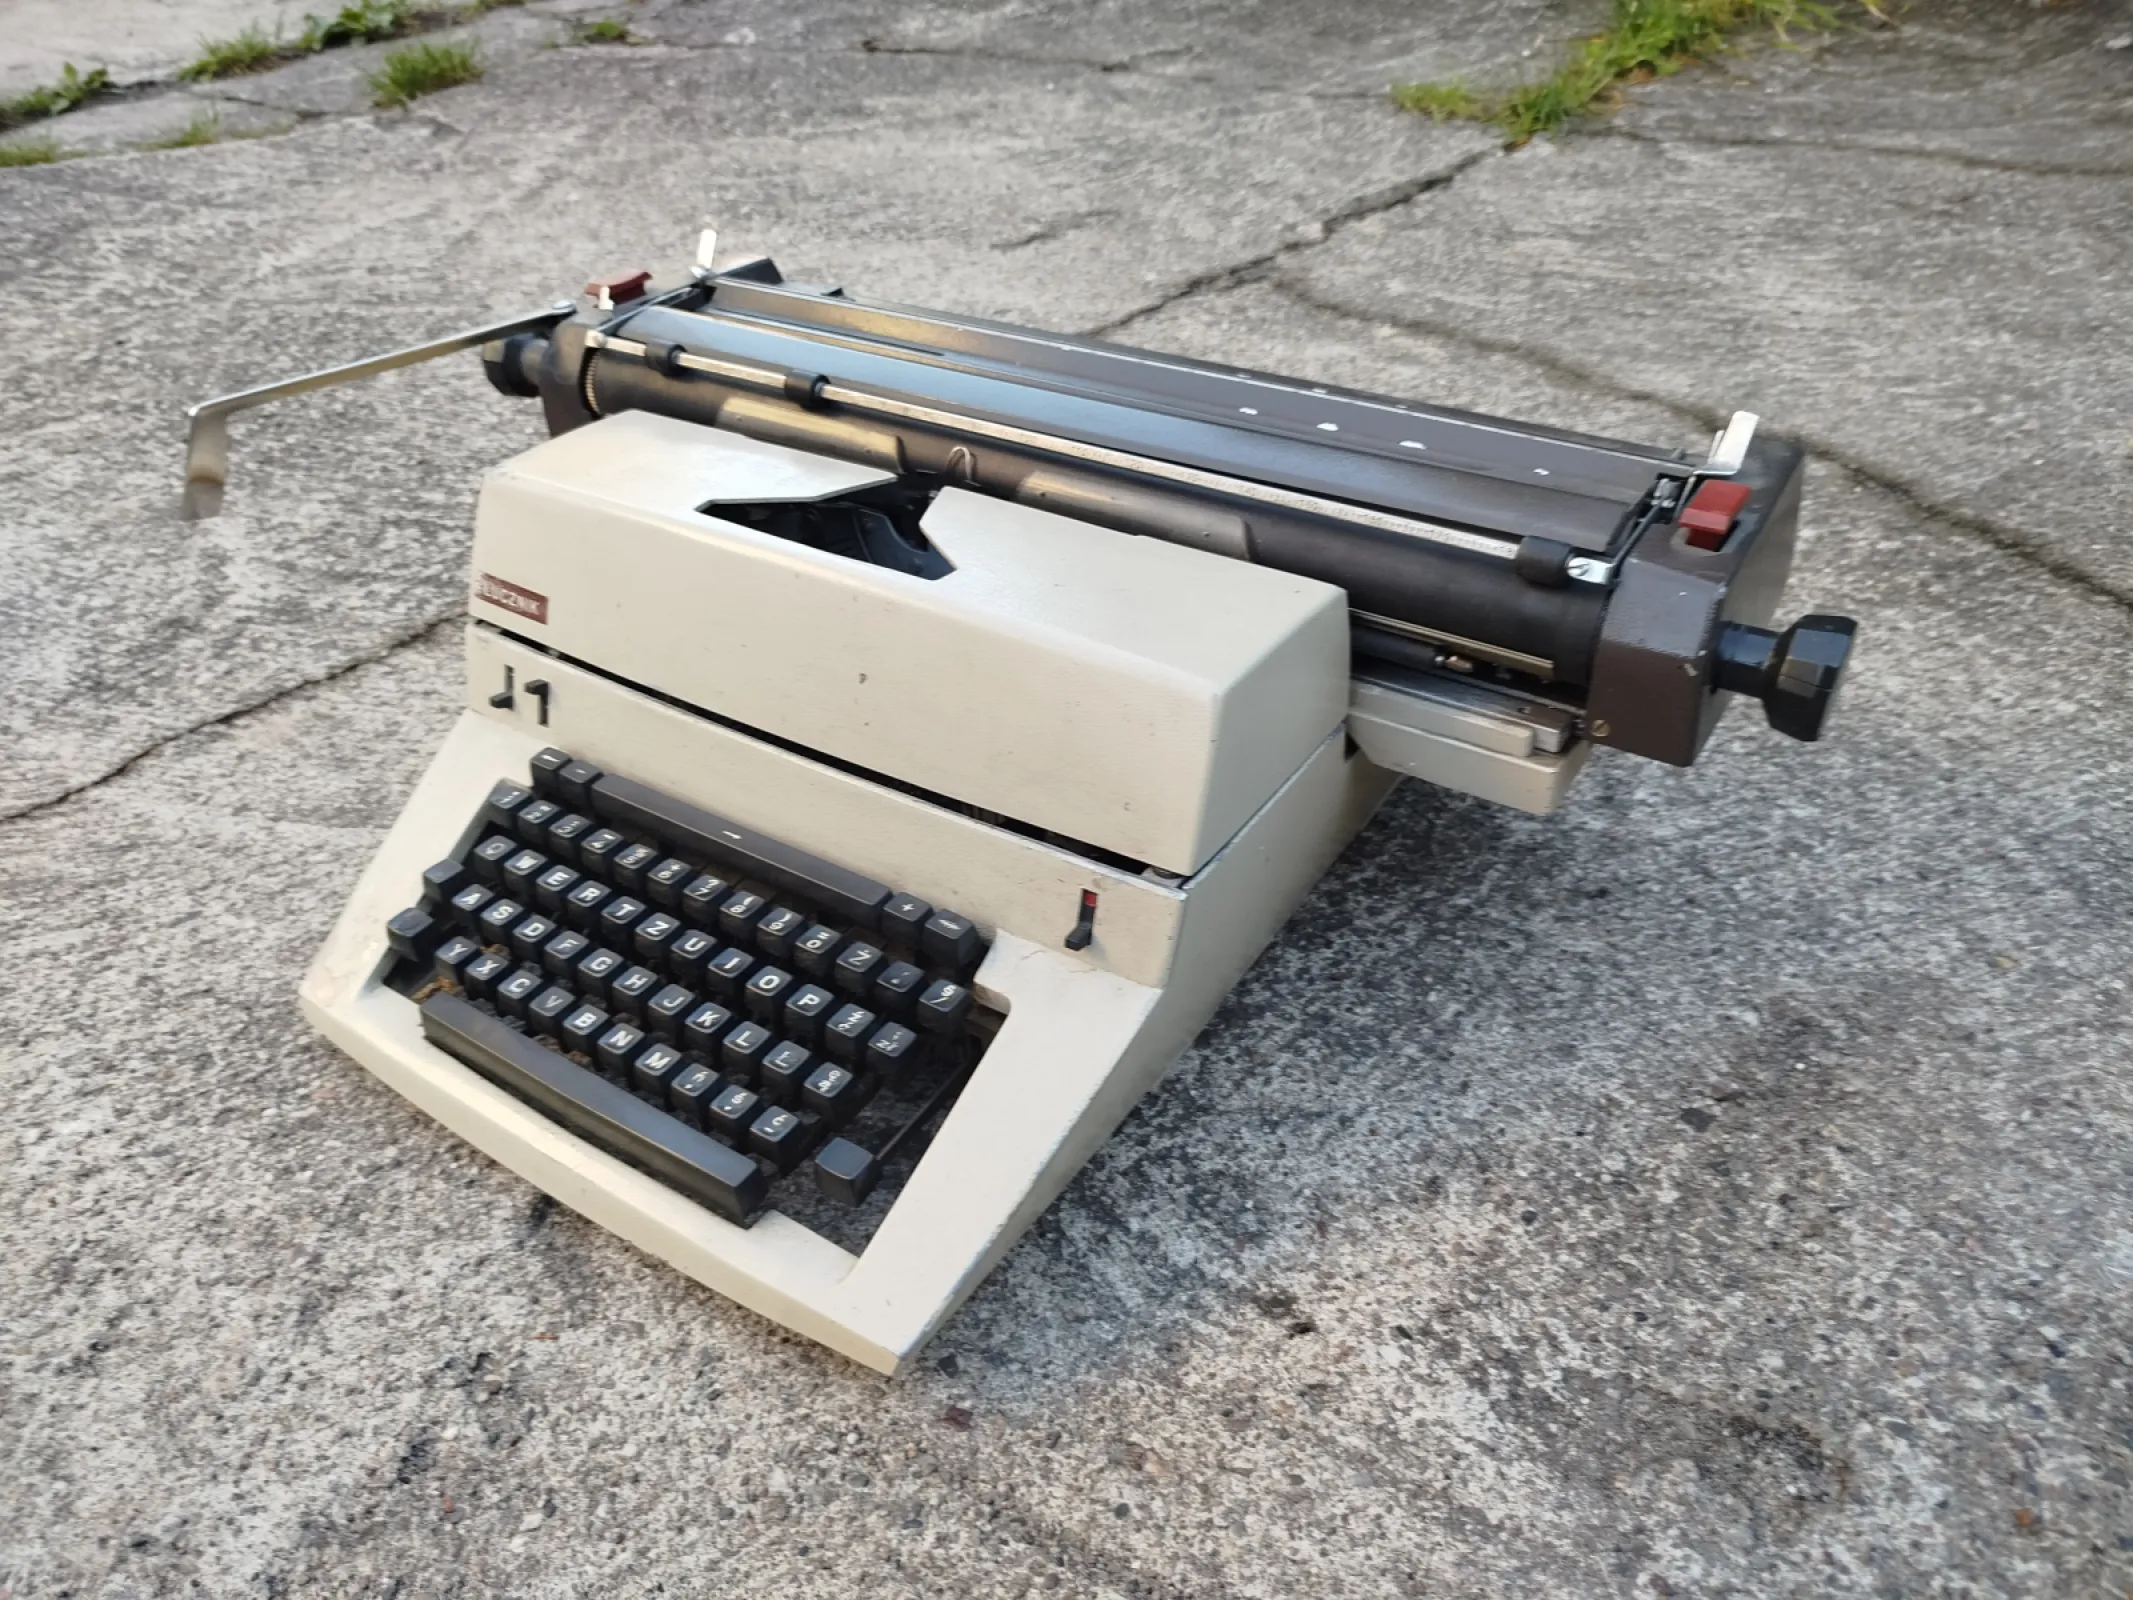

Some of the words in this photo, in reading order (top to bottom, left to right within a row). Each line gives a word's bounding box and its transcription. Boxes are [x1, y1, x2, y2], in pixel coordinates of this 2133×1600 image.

[460, 893, 481, 905] A
[492, 905, 513, 919] S
[523, 922, 545, 936] D
[557, 939, 579, 949] F
[590, 956, 612, 970] G
[624, 974, 648, 989] H
[663, 996, 685, 1008] J
[696, 1010, 720, 1026] K
[735, 1030, 751, 1046] L
[547, 871, 570, 885] E
[579, 887, 601, 901] R
[615, 903, 636, 916] T
[646, 920, 669, 935] Z
[684, 937, 706, 951] U
[724, 957, 740, 969] I
[797, 993, 820, 1005] P
[769, 922, 784, 930] 9
[445, 943, 468, 958] Y
[475, 959, 499, 974] X
[508, 978, 530, 993] C
[545, 995, 563, 1008] V
[573, 1012, 597, 1027] B
[609, 1030, 633, 1046] N
[644, 1051, 671, 1069] M
